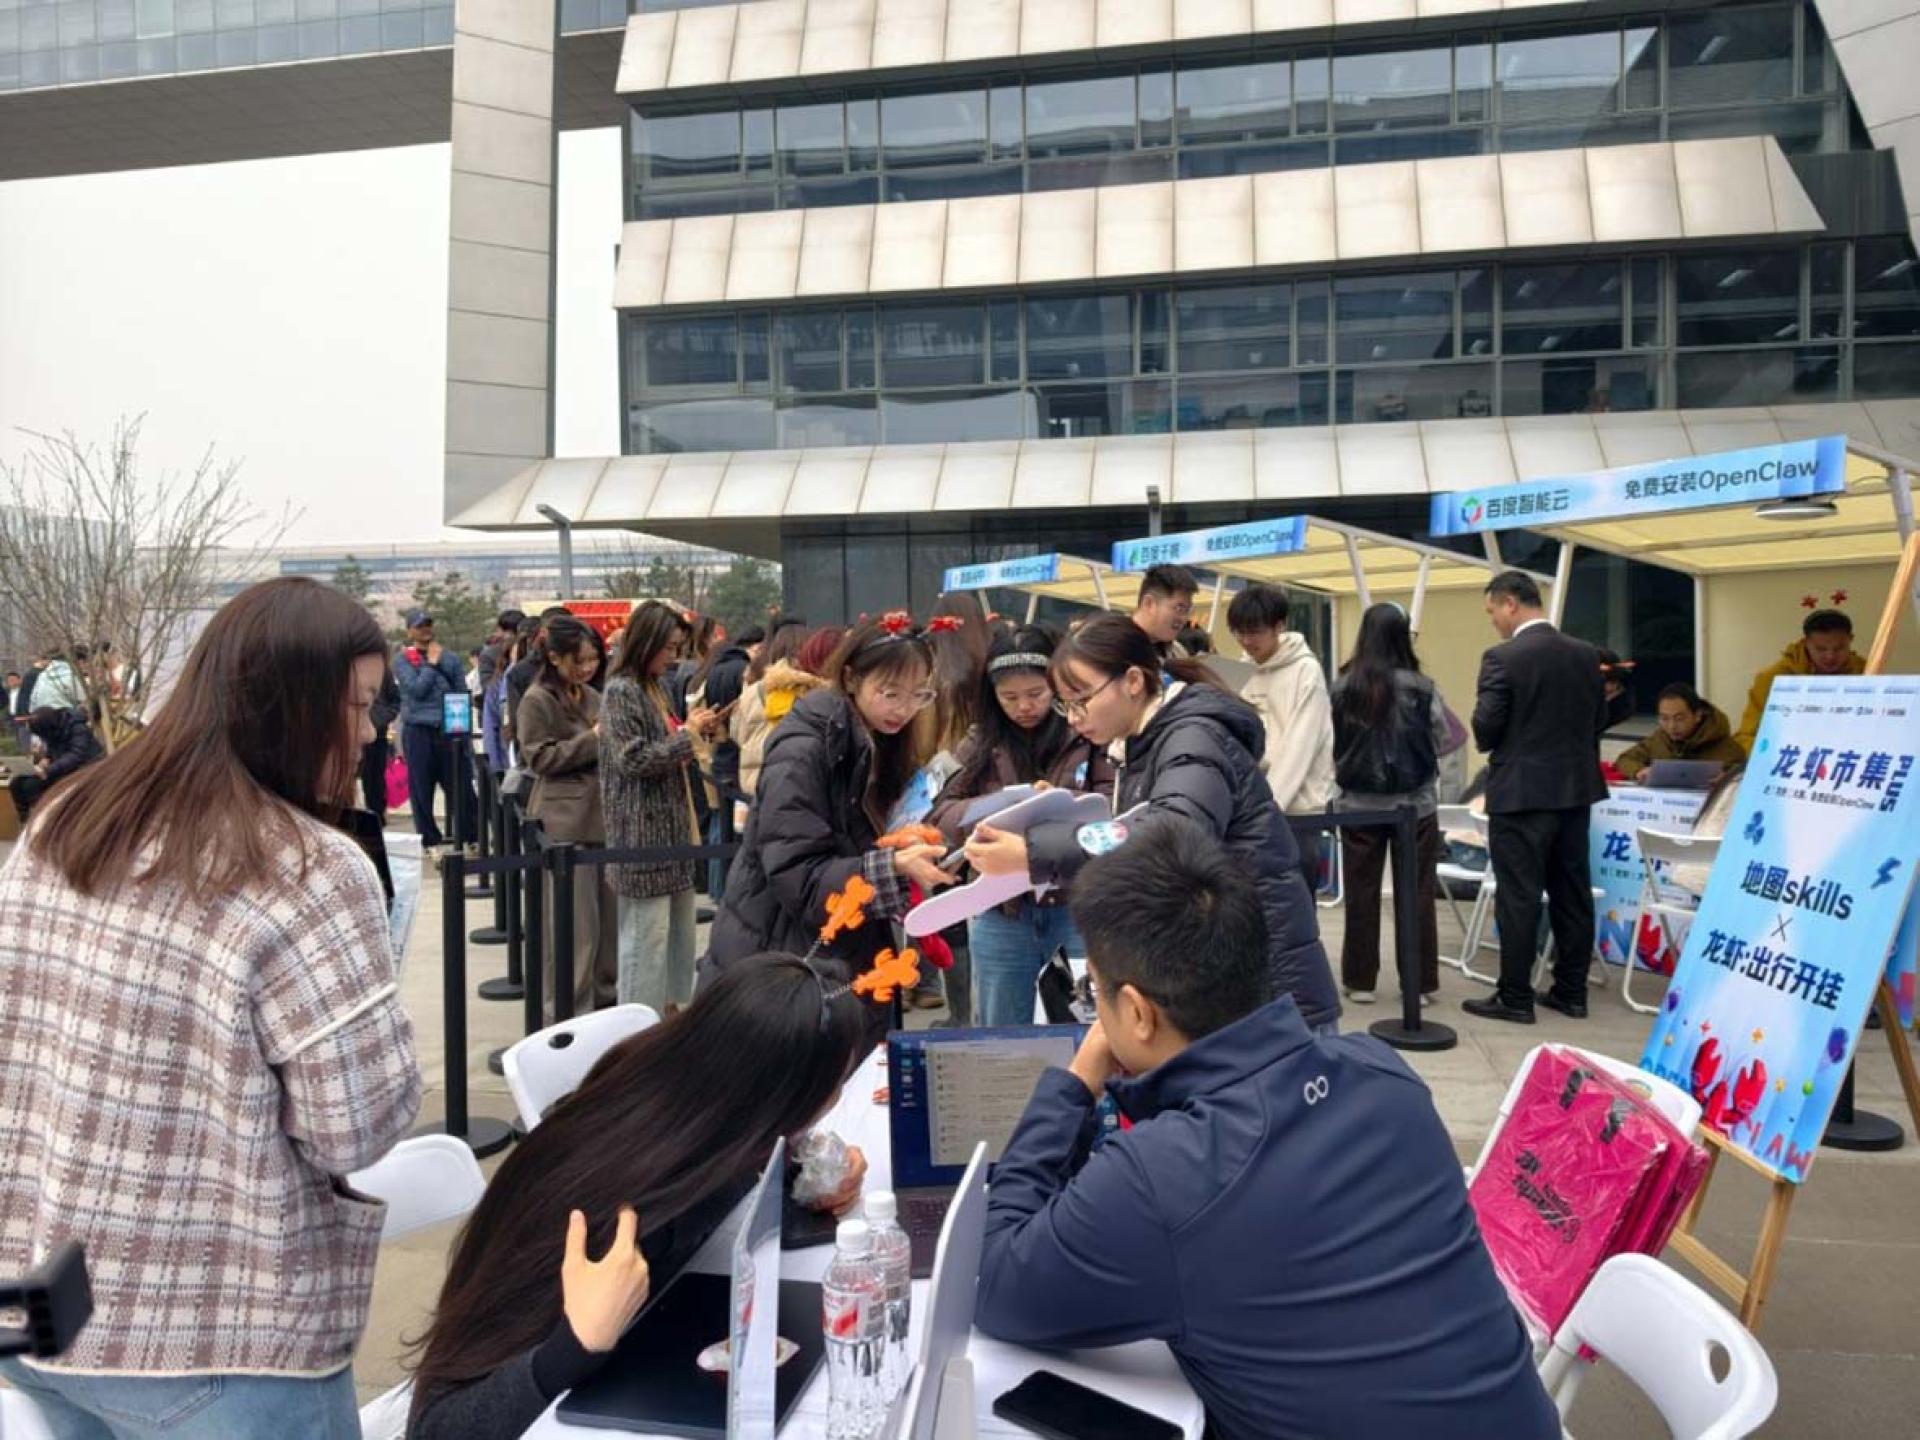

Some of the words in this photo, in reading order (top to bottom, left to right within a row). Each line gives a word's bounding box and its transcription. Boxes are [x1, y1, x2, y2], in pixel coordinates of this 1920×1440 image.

[1486, 488, 1570, 519] 百度智能云
[1624, 458, 1821, 501] 免费安装OpenClaw
[1769, 744, 1894, 791] 龙虾市集
[1740, 860, 1854, 920] 地图skills
